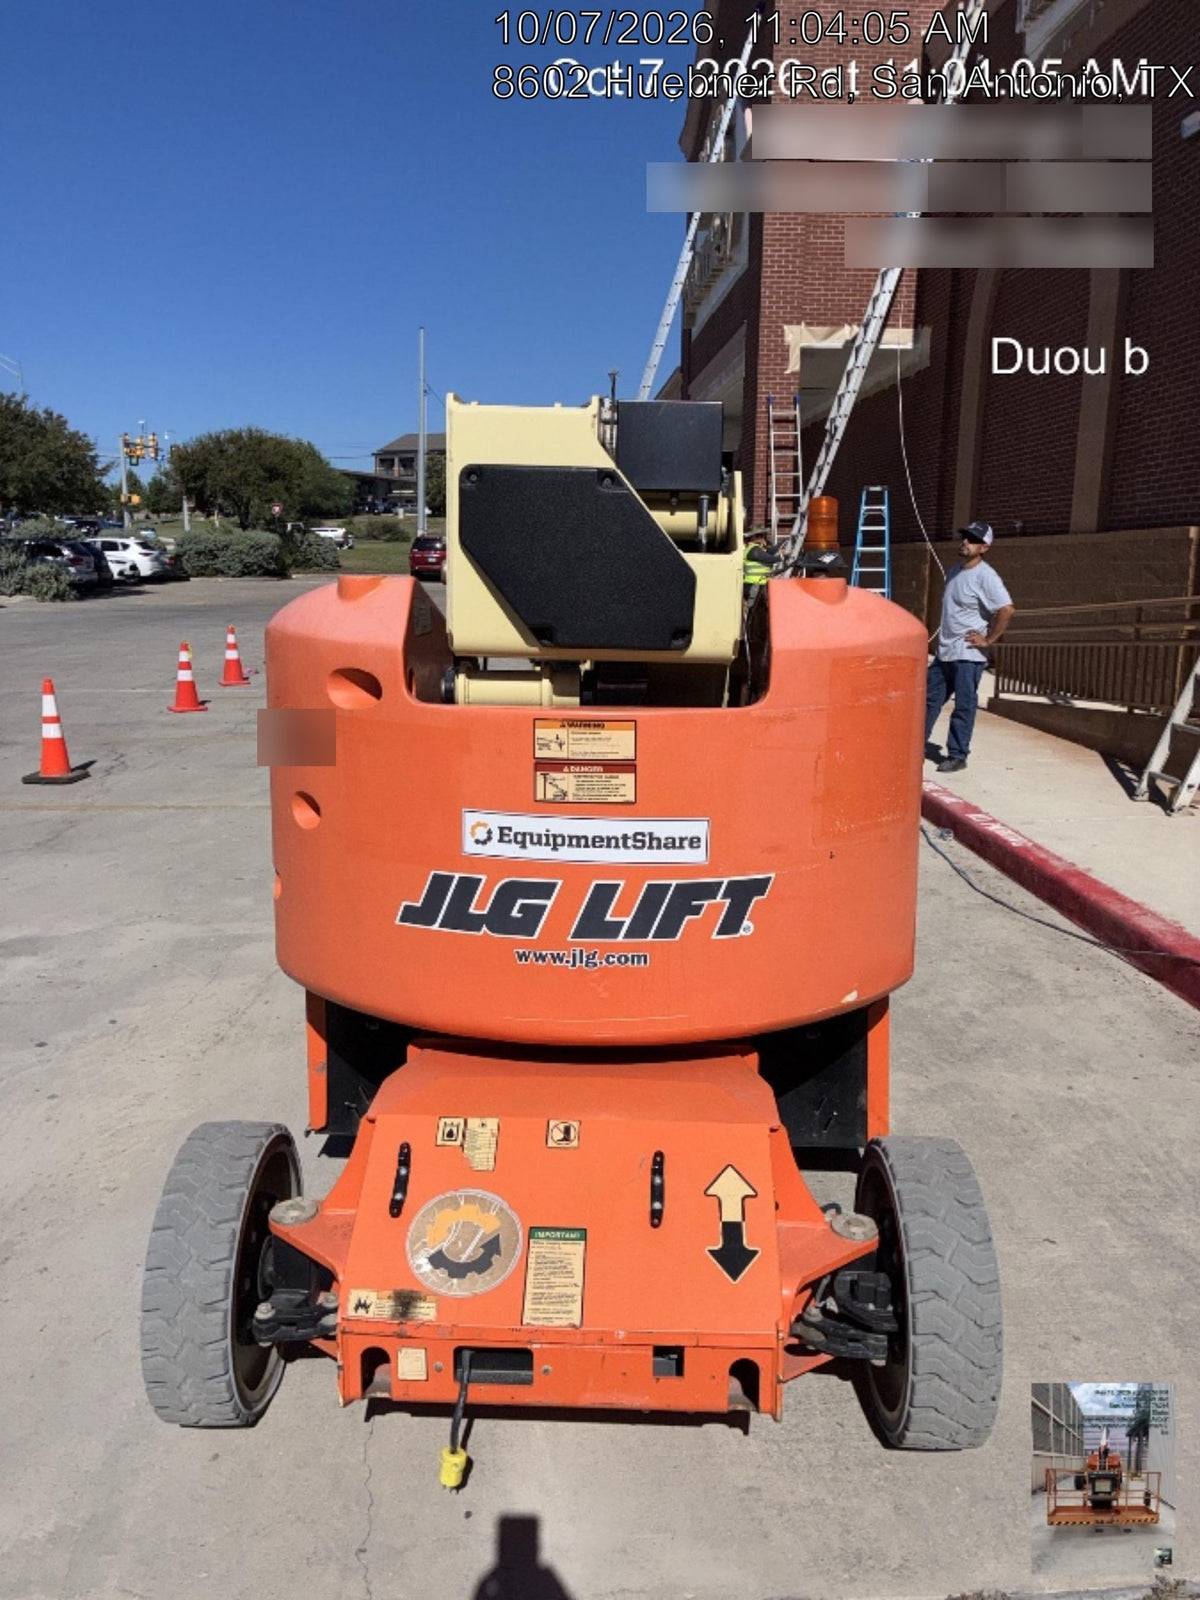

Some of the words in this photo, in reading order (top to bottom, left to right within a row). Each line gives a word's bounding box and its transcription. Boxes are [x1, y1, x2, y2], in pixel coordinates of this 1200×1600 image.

[497, 826, 701, 850] EquipmentShare
[396, 871, 563, 940] JLG
[567, 873, 776, 941] LIFT
[515, 949, 649, 970] www.jlg.com
